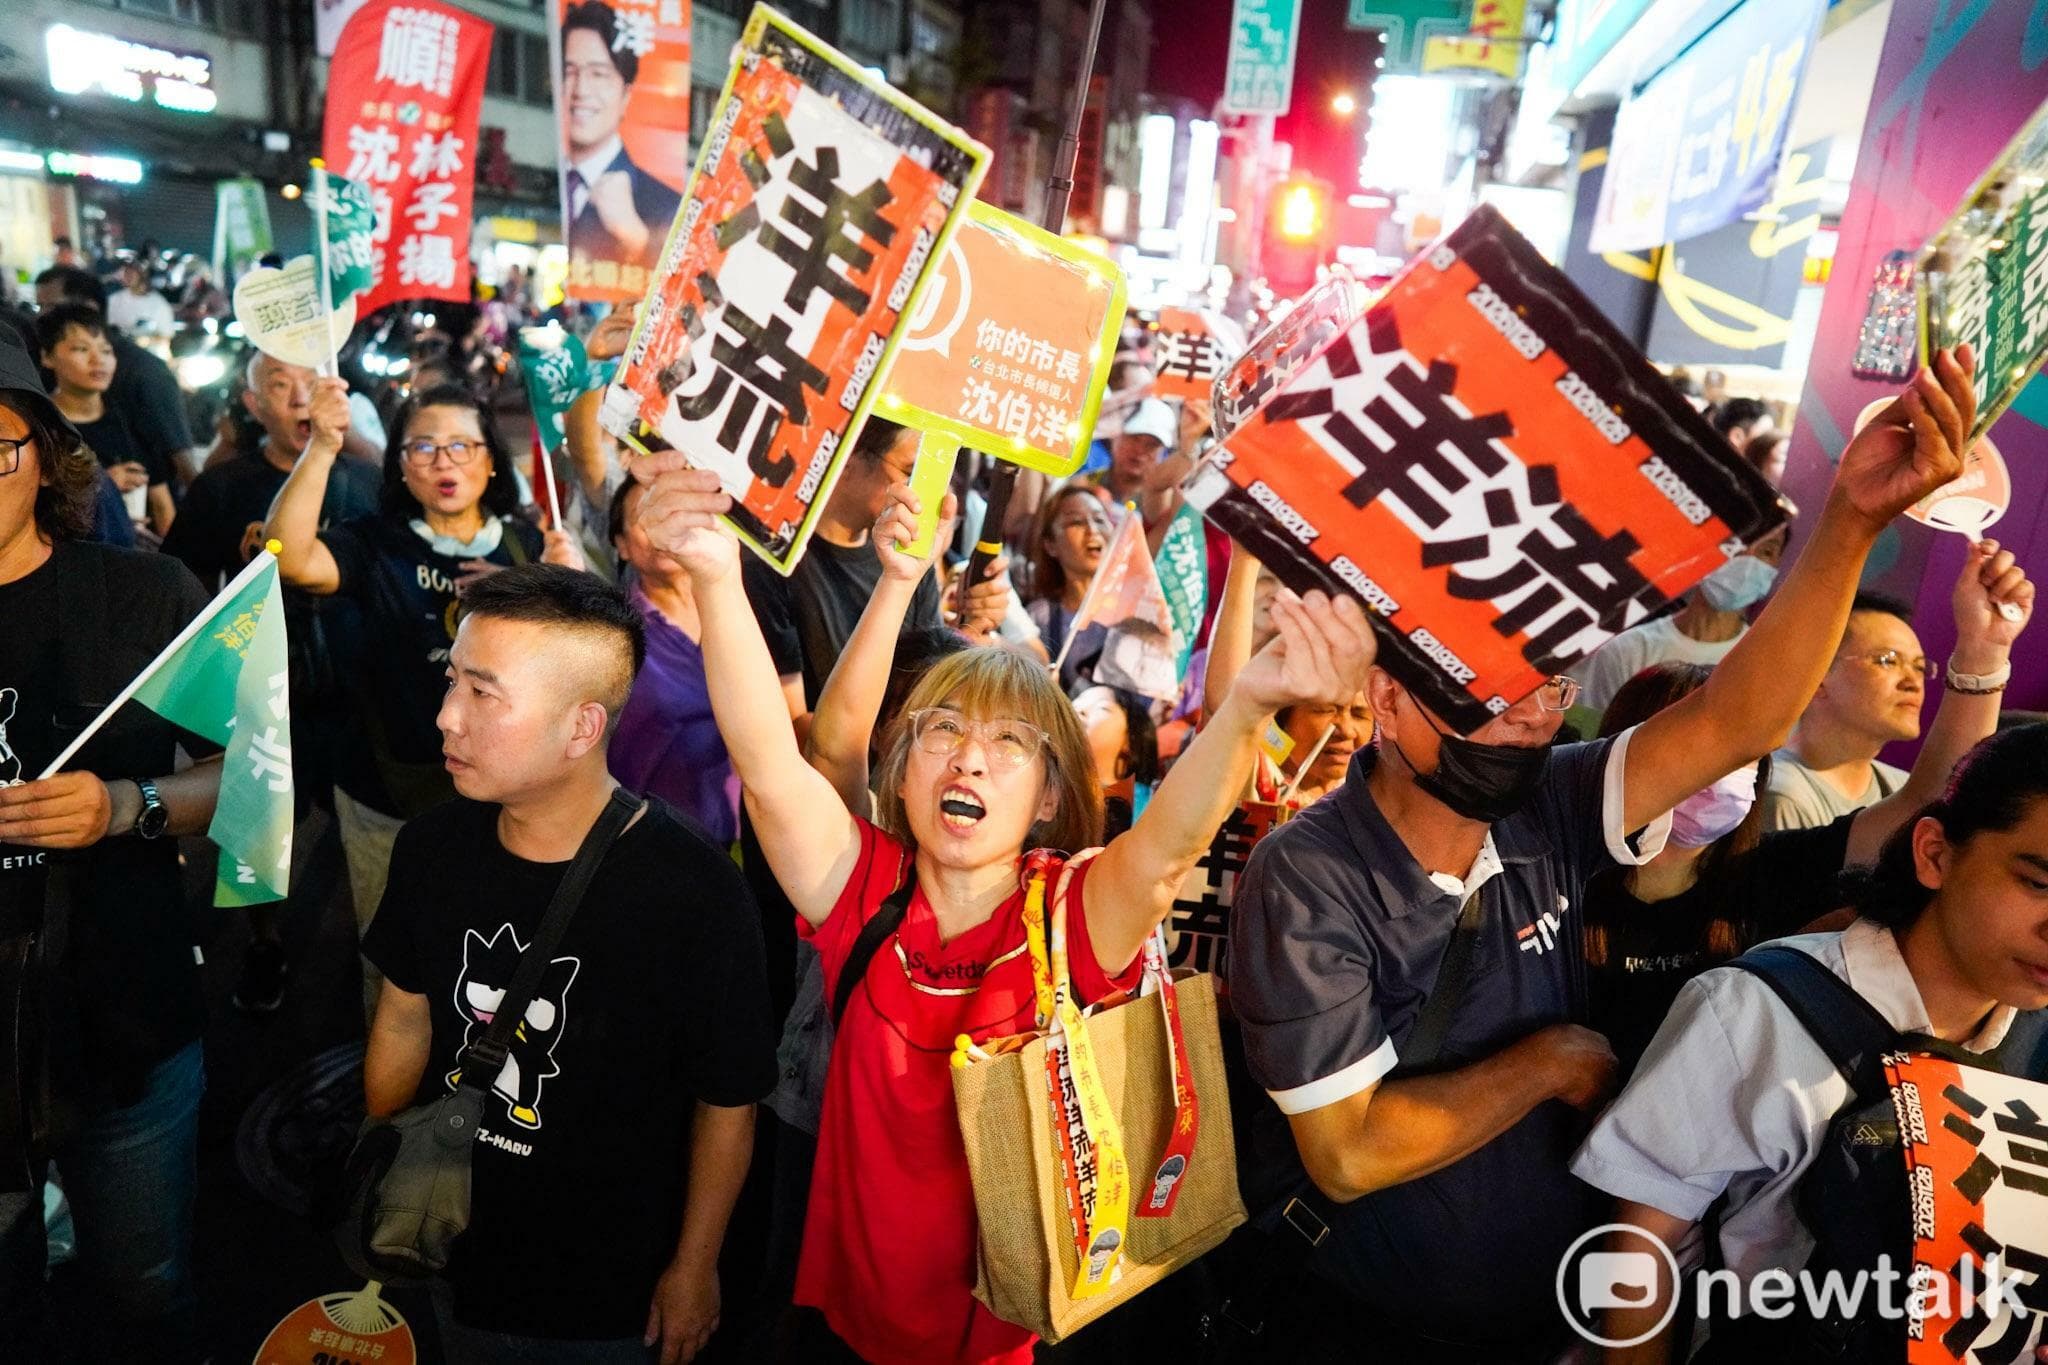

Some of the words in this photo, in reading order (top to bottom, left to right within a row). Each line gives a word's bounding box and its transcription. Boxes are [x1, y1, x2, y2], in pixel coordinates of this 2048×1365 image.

[656, 111, 899, 489] 洋流
[887, 227, 935, 312] 20261128
[975, 318, 1082, 384] 你的市長
[1466, 283, 1546, 360] 20261128
[840, 331, 886, 412] 20261128
[983, 359, 1073, 404] 台北市長候選人
[958, 376, 1068, 448] 沈伯洋
[1555, 371, 1631, 445] 20261128
[796, 429, 840, 504] 20261128
[1264, 303, 1668, 676] 洋流
[1639, 456, 1712, 525] 20261128
[1247, 480, 1320, 545] 20261128
[1329, 555, 1400, 617] 20261128
[1409, 627, 1477, 685] 20261128
[1902, 1082, 1928, 1145] 20261128
[1916, 1166, 1935, 1239] 20261128
[308, 1327, 386, 1360] 台北順起來
